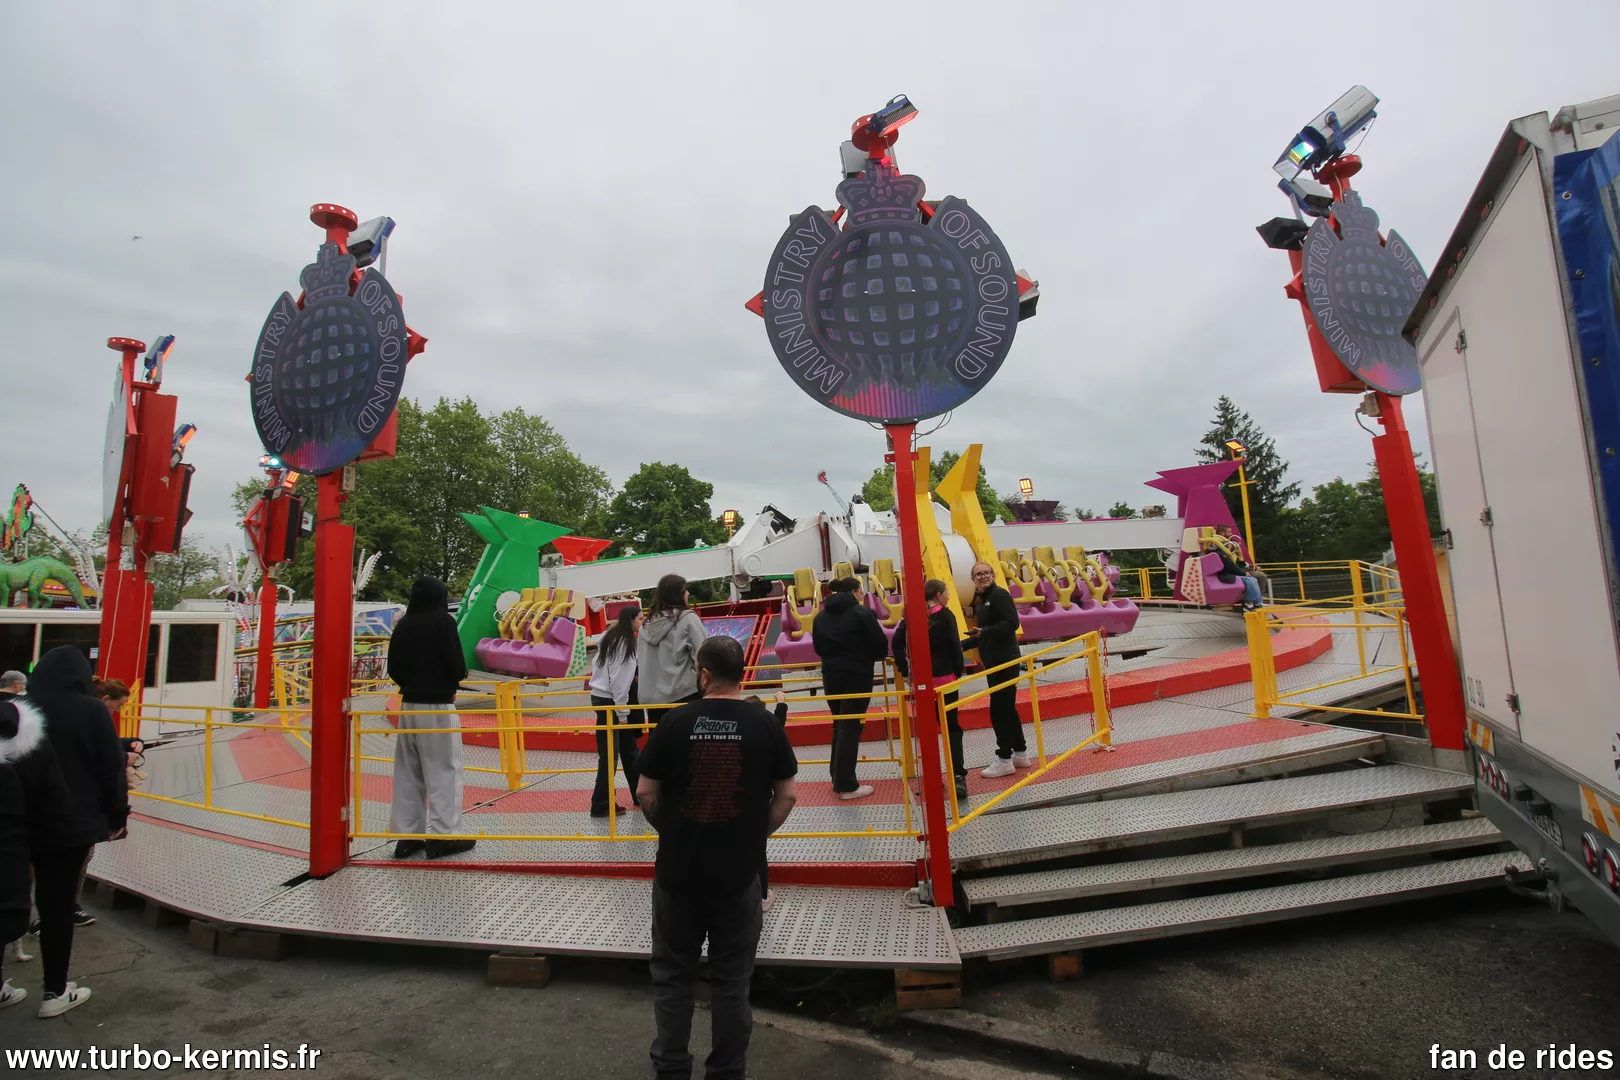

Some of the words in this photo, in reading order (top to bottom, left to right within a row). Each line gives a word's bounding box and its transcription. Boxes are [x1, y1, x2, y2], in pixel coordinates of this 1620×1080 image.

[772, 216, 844, 394] MINISTRY
[1309, 225, 1361, 365] MINISTRY
[255, 301, 291, 451] MINISTRY
[695, 721, 737, 732] PRODIGY
